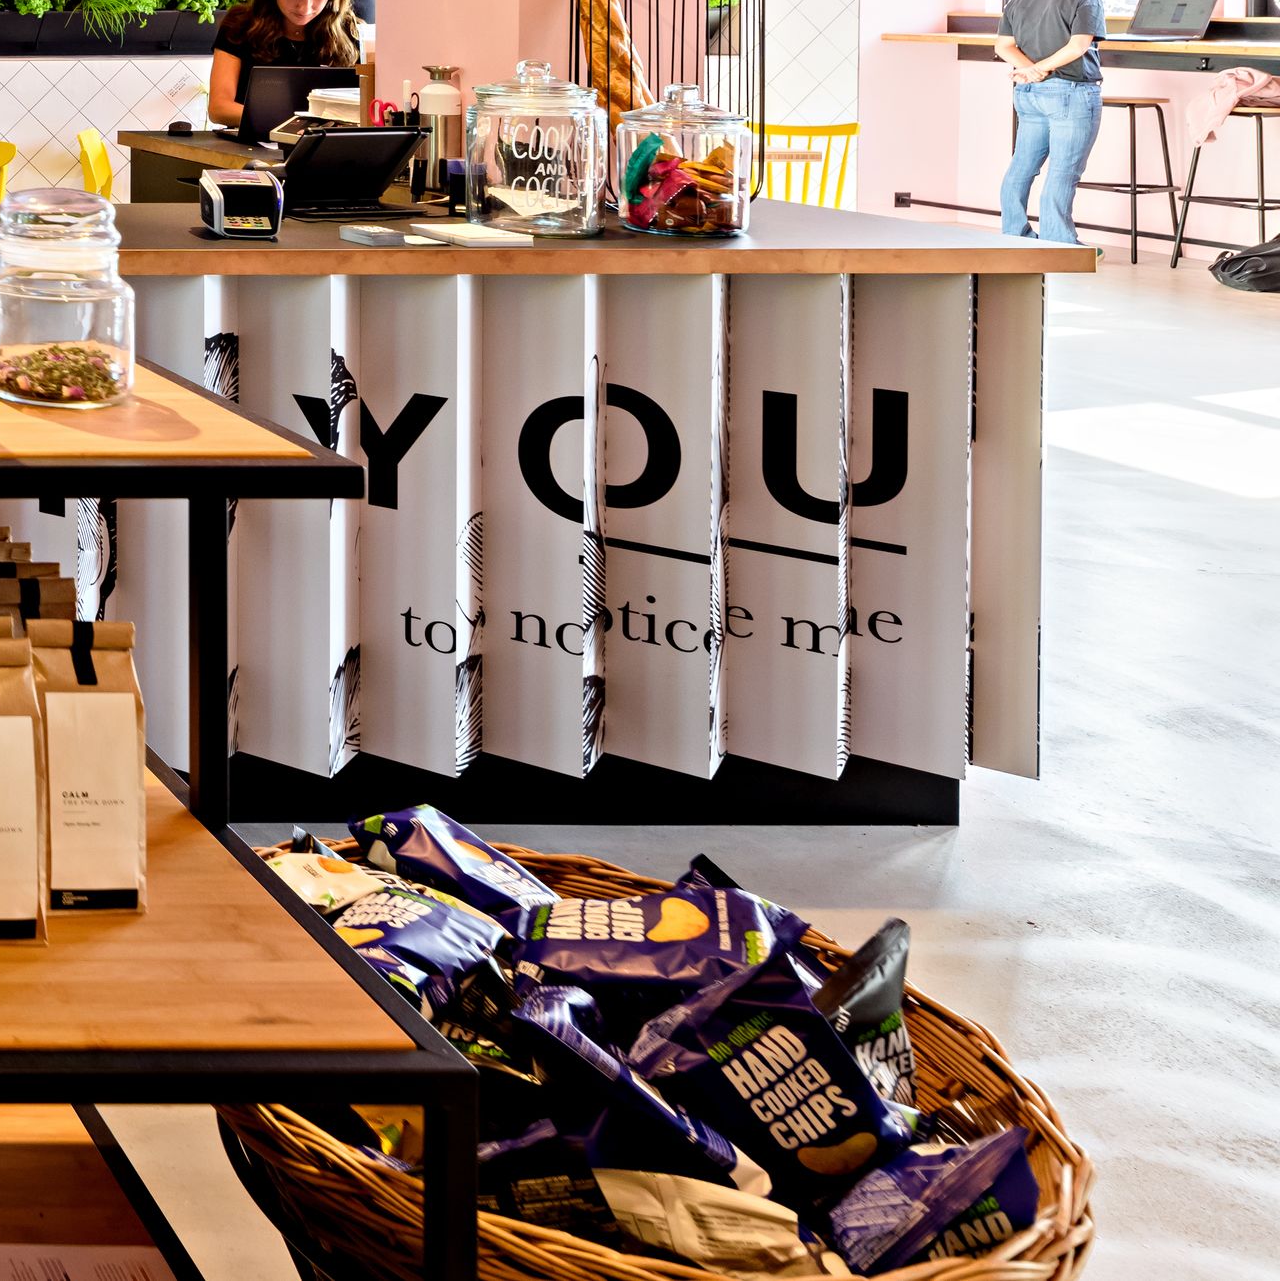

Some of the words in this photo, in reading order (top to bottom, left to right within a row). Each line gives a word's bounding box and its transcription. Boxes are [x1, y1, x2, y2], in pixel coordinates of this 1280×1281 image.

[512, 123, 592, 162] COOKIE
[535, 163, 568, 176] AND
[293, 383, 910, 525] YOU
[402, 605, 457, 656] to
[510, 595, 755, 657] notice
[781, 599, 905, 656] me
[721, 1024, 808, 1100] HAND
[750, 1058, 832, 1123] COOKED
[769, 1084, 858, 1150] CHIPS
